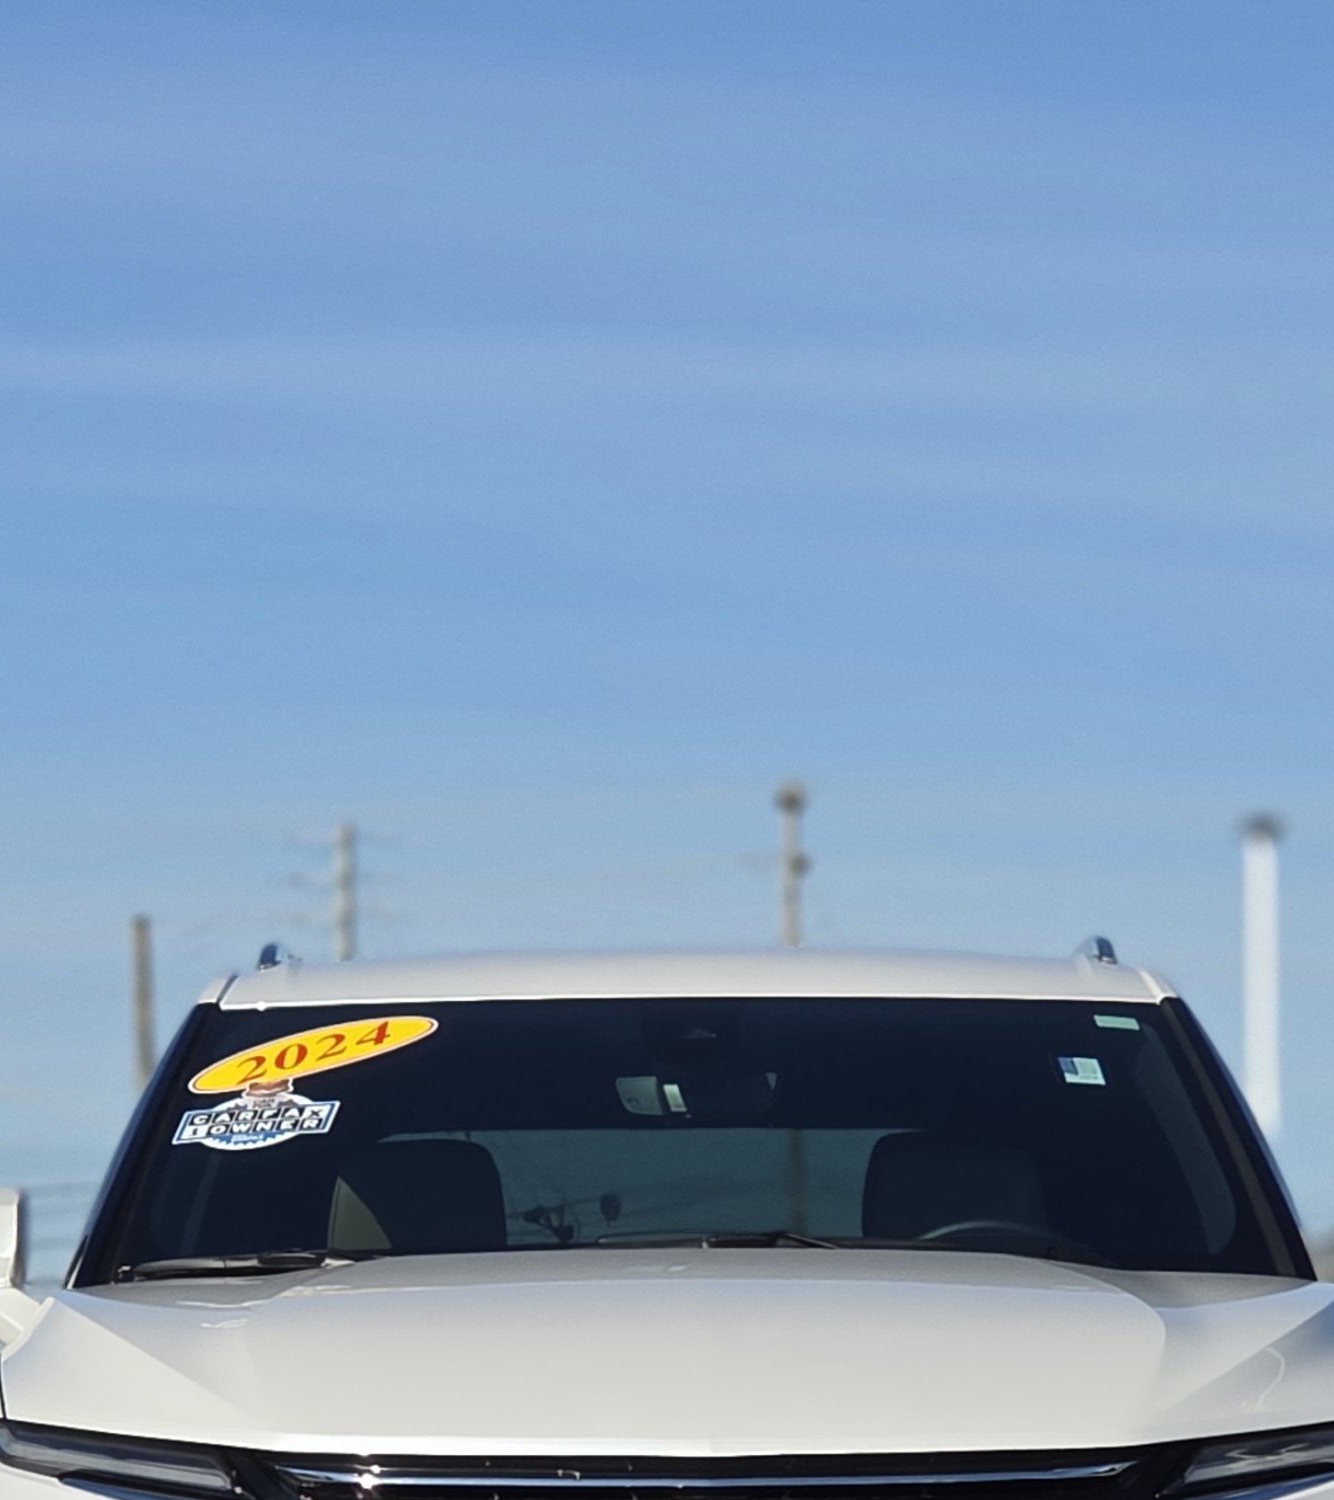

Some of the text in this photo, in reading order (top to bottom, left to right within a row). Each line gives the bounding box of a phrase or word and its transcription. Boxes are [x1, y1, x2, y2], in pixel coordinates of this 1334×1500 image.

[236, 1021, 391, 1086] 2024
[192, 1108, 323, 1125] CARFAX
[209, 1119, 320, 1136] OWNER
